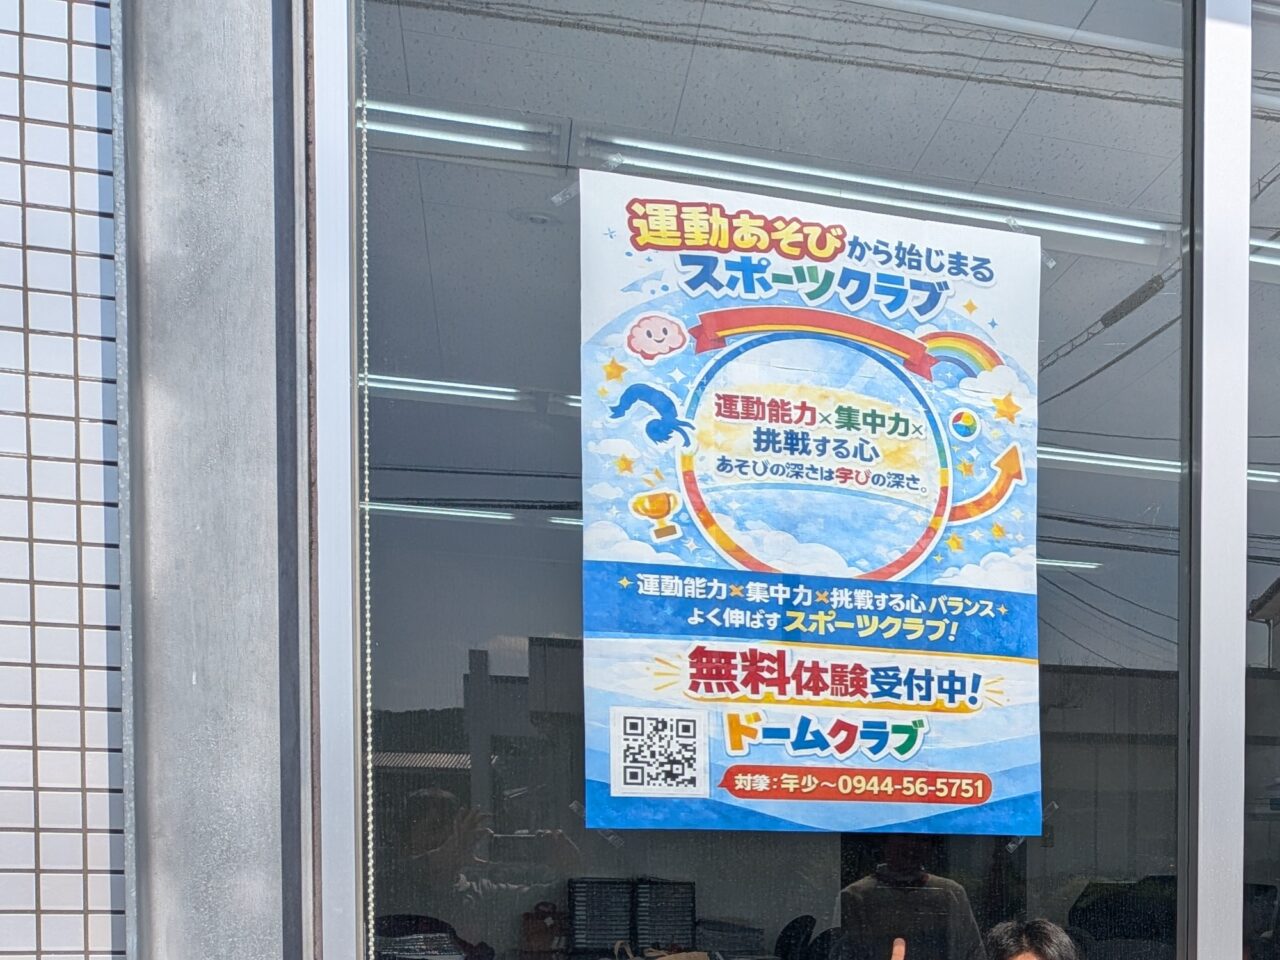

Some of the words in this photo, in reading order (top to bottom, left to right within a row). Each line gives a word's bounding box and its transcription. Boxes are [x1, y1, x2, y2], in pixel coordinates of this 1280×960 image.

[628, 199, 995, 282] 運動あそびから始じまる
[679, 253, 951, 317] スポーツクラブ
[753, 426, 880, 463] 挑戦する心
[688, 645, 982, 706] 無料体験受付中!
[726, 711, 925, 755] ドームクラブ
